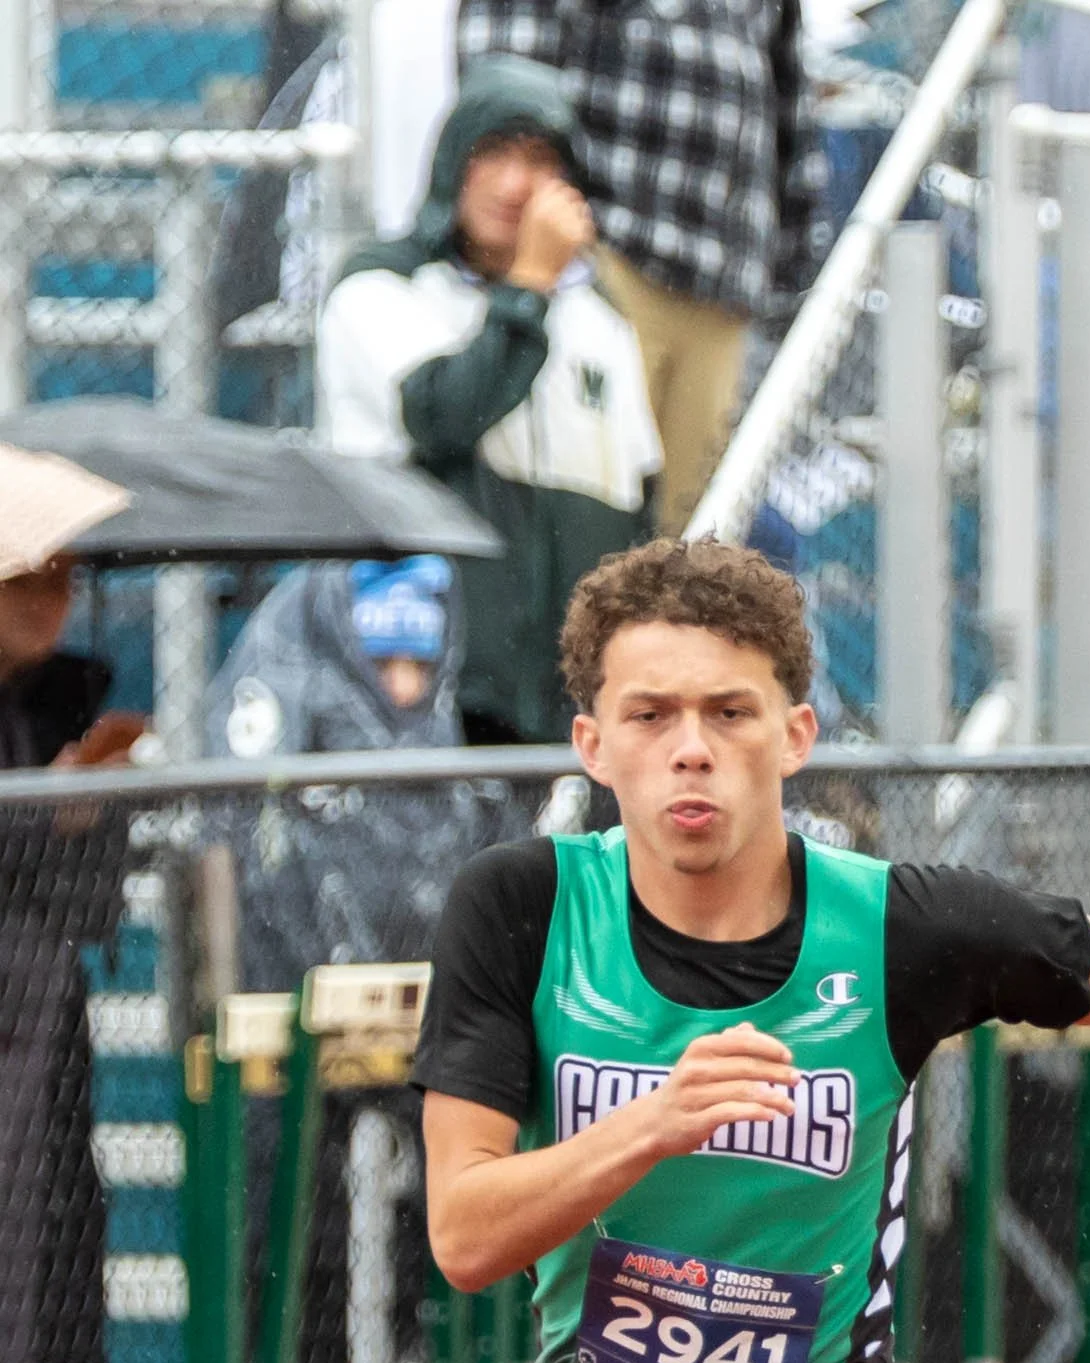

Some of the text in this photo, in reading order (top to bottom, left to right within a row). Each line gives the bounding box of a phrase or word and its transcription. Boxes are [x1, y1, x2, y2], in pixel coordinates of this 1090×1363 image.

[715, 1269, 774, 1290] CROSS
[652, 1285, 708, 1311] REGIONAL
[710, 1298, 797, 1320] CHAMPIONSHIP
[712, 1283, 792, 1304] COUNTRY
